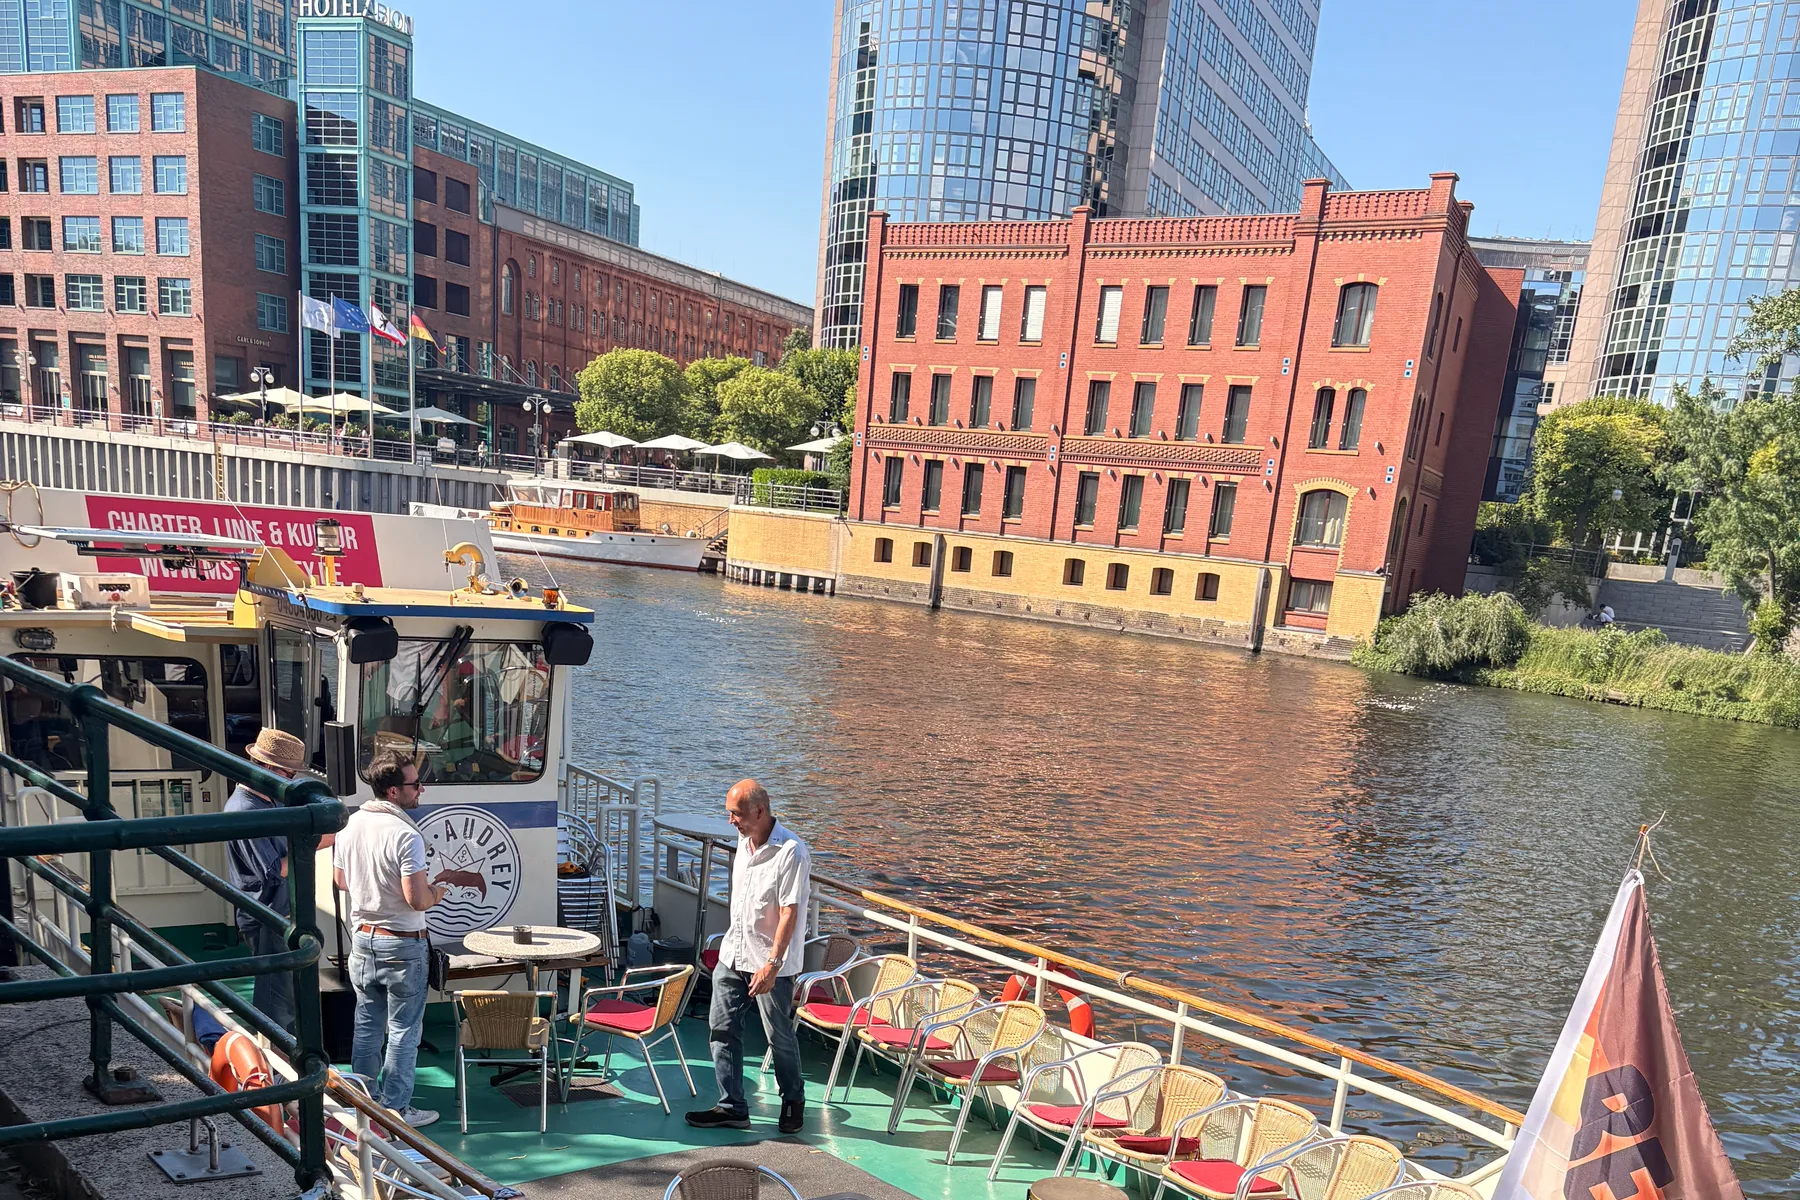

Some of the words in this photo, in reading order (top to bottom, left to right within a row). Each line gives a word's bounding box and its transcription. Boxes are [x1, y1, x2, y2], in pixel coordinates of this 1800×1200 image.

[299, 0, 362, 17] HOTEL
[269, 520, 283, 545] &
[444, 817, 512, 891] AUDREY
